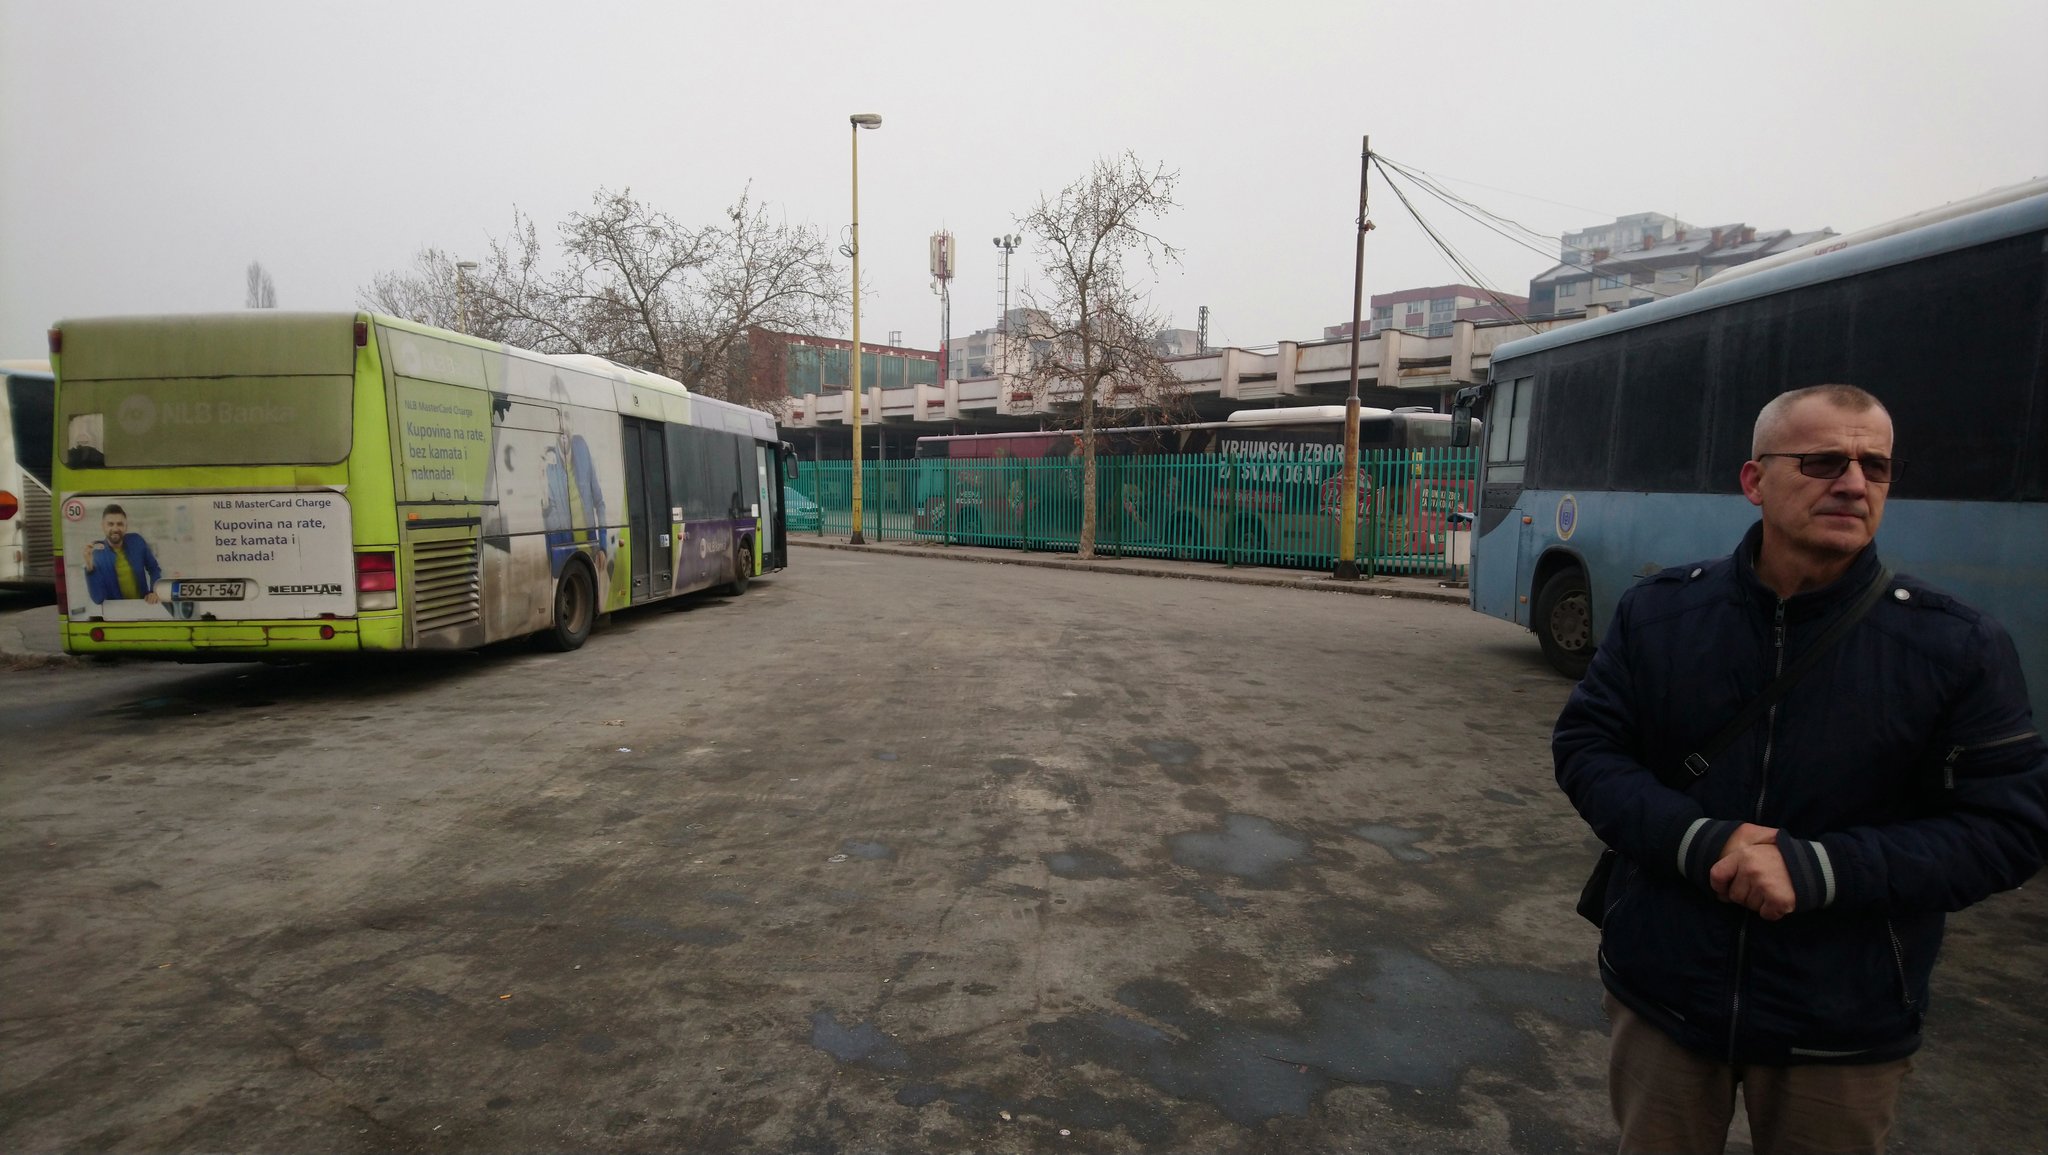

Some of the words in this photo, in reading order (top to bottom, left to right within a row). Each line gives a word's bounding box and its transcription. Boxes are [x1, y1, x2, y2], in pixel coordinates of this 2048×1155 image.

[162, 401, 211, 424] NLB
[217, 399, 297, 424] Banka
[404, 400, 418, 410] NLB
[406, 422, 451, 440] Kupovina
[453, 428, 465, 440] na
[408, 442, 427, 459] bez
[428, 443, 463, 460] kamata
[1221, 440, 1295, 462] VRHUNSKI
[1299, 442, 1345, 463] IZBOR
[411, 465, 455, 480] naknada!
[69, 505, 81, 517] 50
[213, 500, 232, 509] NLB
[235, 499, 292, 509] MasterCard
[295, 498, 331, 510] Charge
[214, 519, 273, 532] Kupovina
[277, 521, 293, 529] na
[297, 518, 326, 529] rate,
[215, 536, 237, 546] bez
[241, 535, 288, 546] kamata
[216, 551, 275, 562] naknada!
[180, 583, 242, 597] E96-T-547
[268, 584, 342, 595] NEOPLAN
